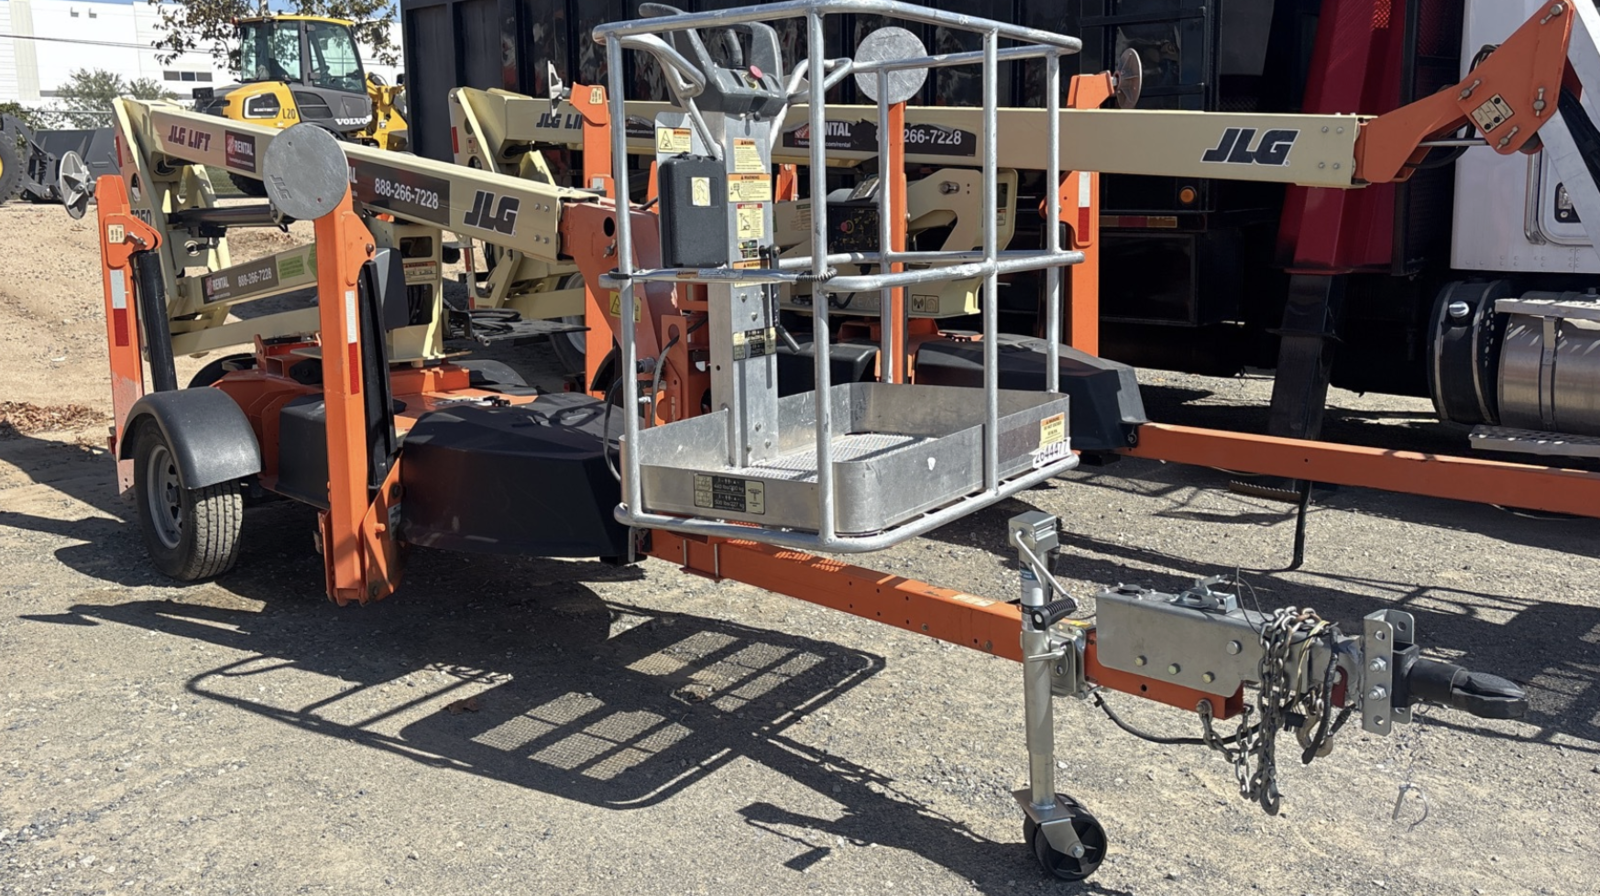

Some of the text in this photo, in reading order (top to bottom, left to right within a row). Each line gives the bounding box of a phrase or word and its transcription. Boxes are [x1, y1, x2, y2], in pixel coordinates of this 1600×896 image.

[282, 108, 296, 119] L20
[168, 124, 211, 151] JLG LIFT
[234, 140, 254, 156] RENTAL
[1201, 127, 1300, 166] JLG
[375, 177, 439, 210] 888-266-7228
[462, 189, 520, 237] JLG
[212, 276, 230, 291] RENTAL
